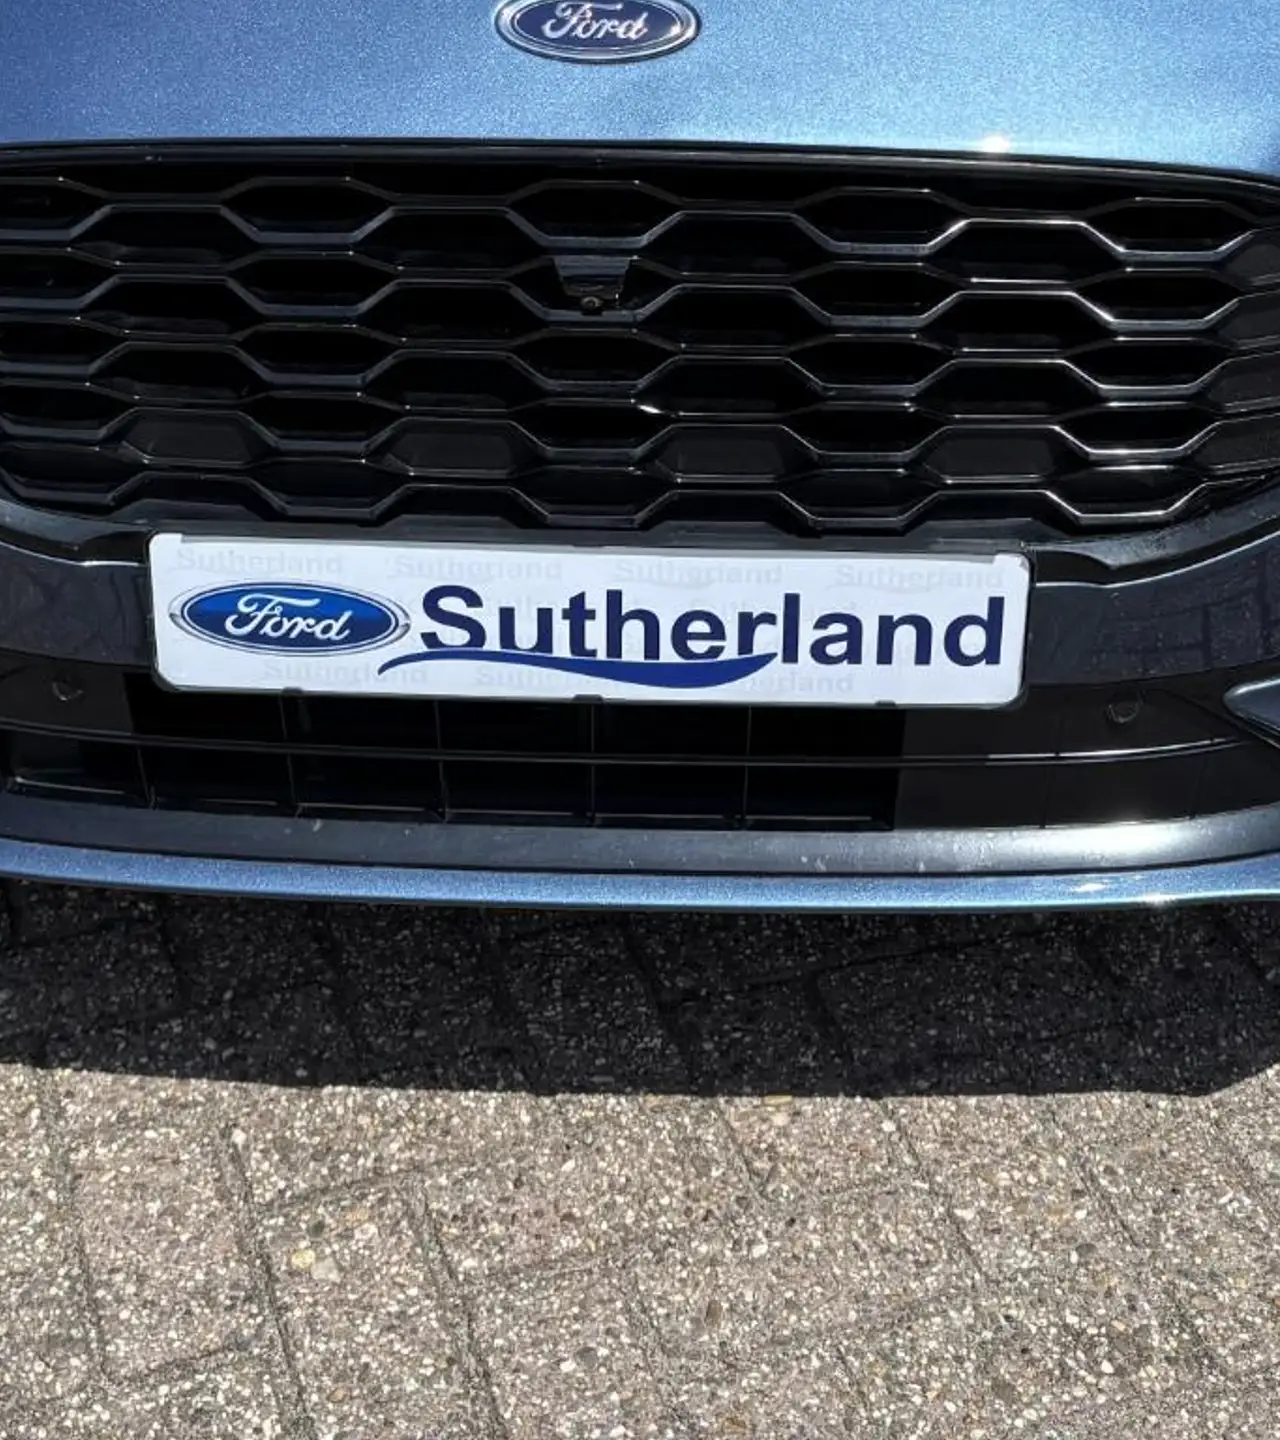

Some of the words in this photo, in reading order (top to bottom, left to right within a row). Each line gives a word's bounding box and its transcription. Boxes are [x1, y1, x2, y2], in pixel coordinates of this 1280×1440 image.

[541, 1, 649, 40] Ford
[225, 594, 354, 641] Ford
[420, 585, 1005, 666] Sutherland
